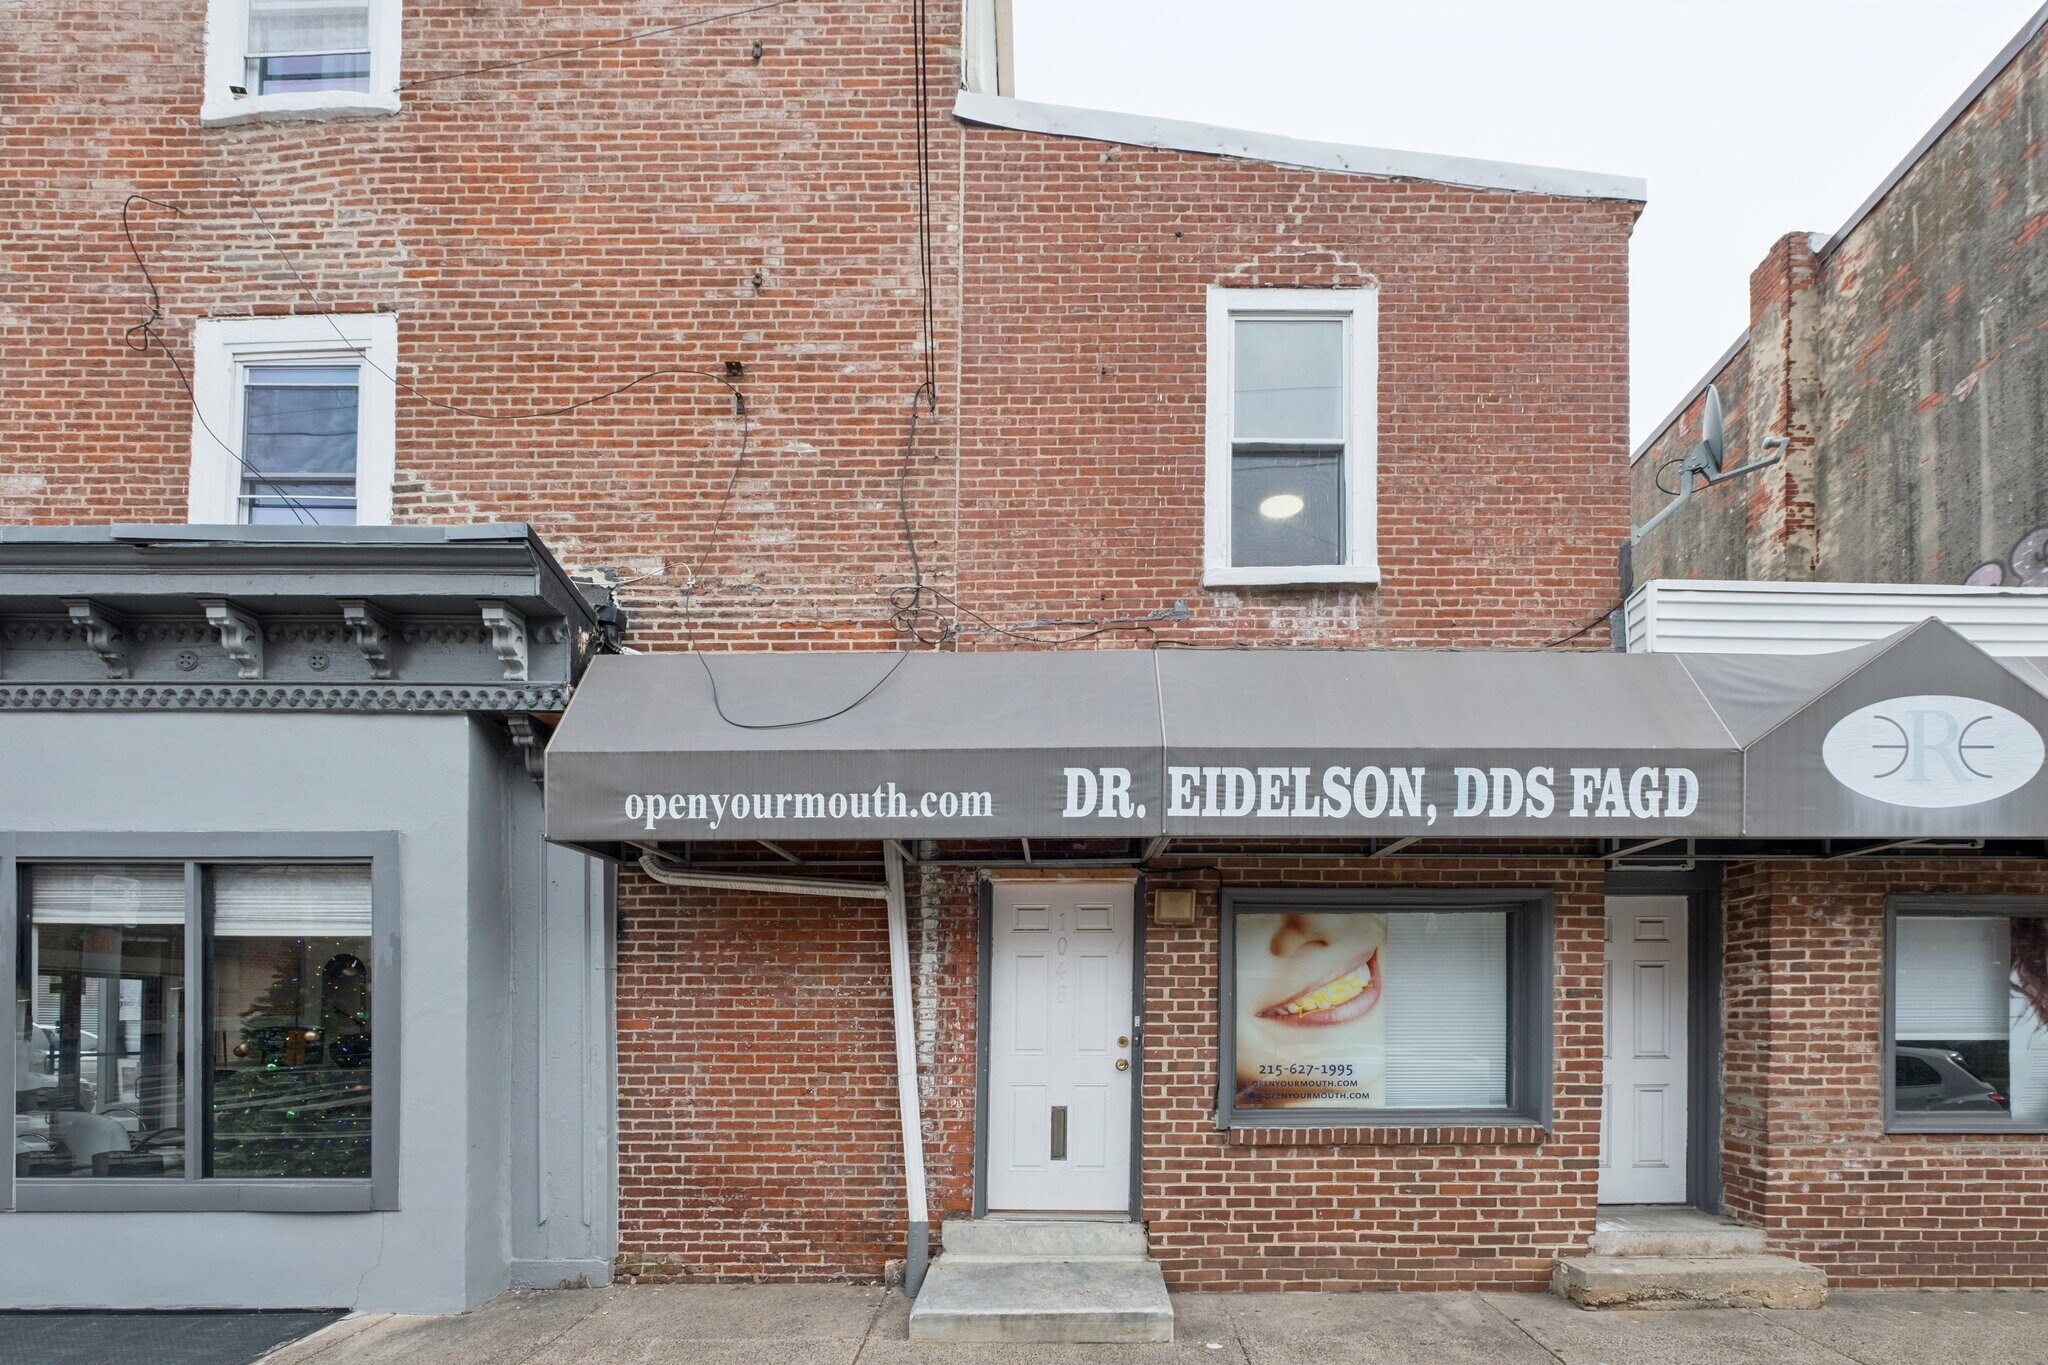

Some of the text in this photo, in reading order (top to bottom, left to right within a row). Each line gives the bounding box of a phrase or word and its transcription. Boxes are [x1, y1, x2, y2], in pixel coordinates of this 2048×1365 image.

[624, 782, 994, 830] openyourmouth.com
[1062, 765, 1700, 827] DR. EIDELSON, DDS FAGD
[1259, 1063, 1353, 1076] 215-627-1995
